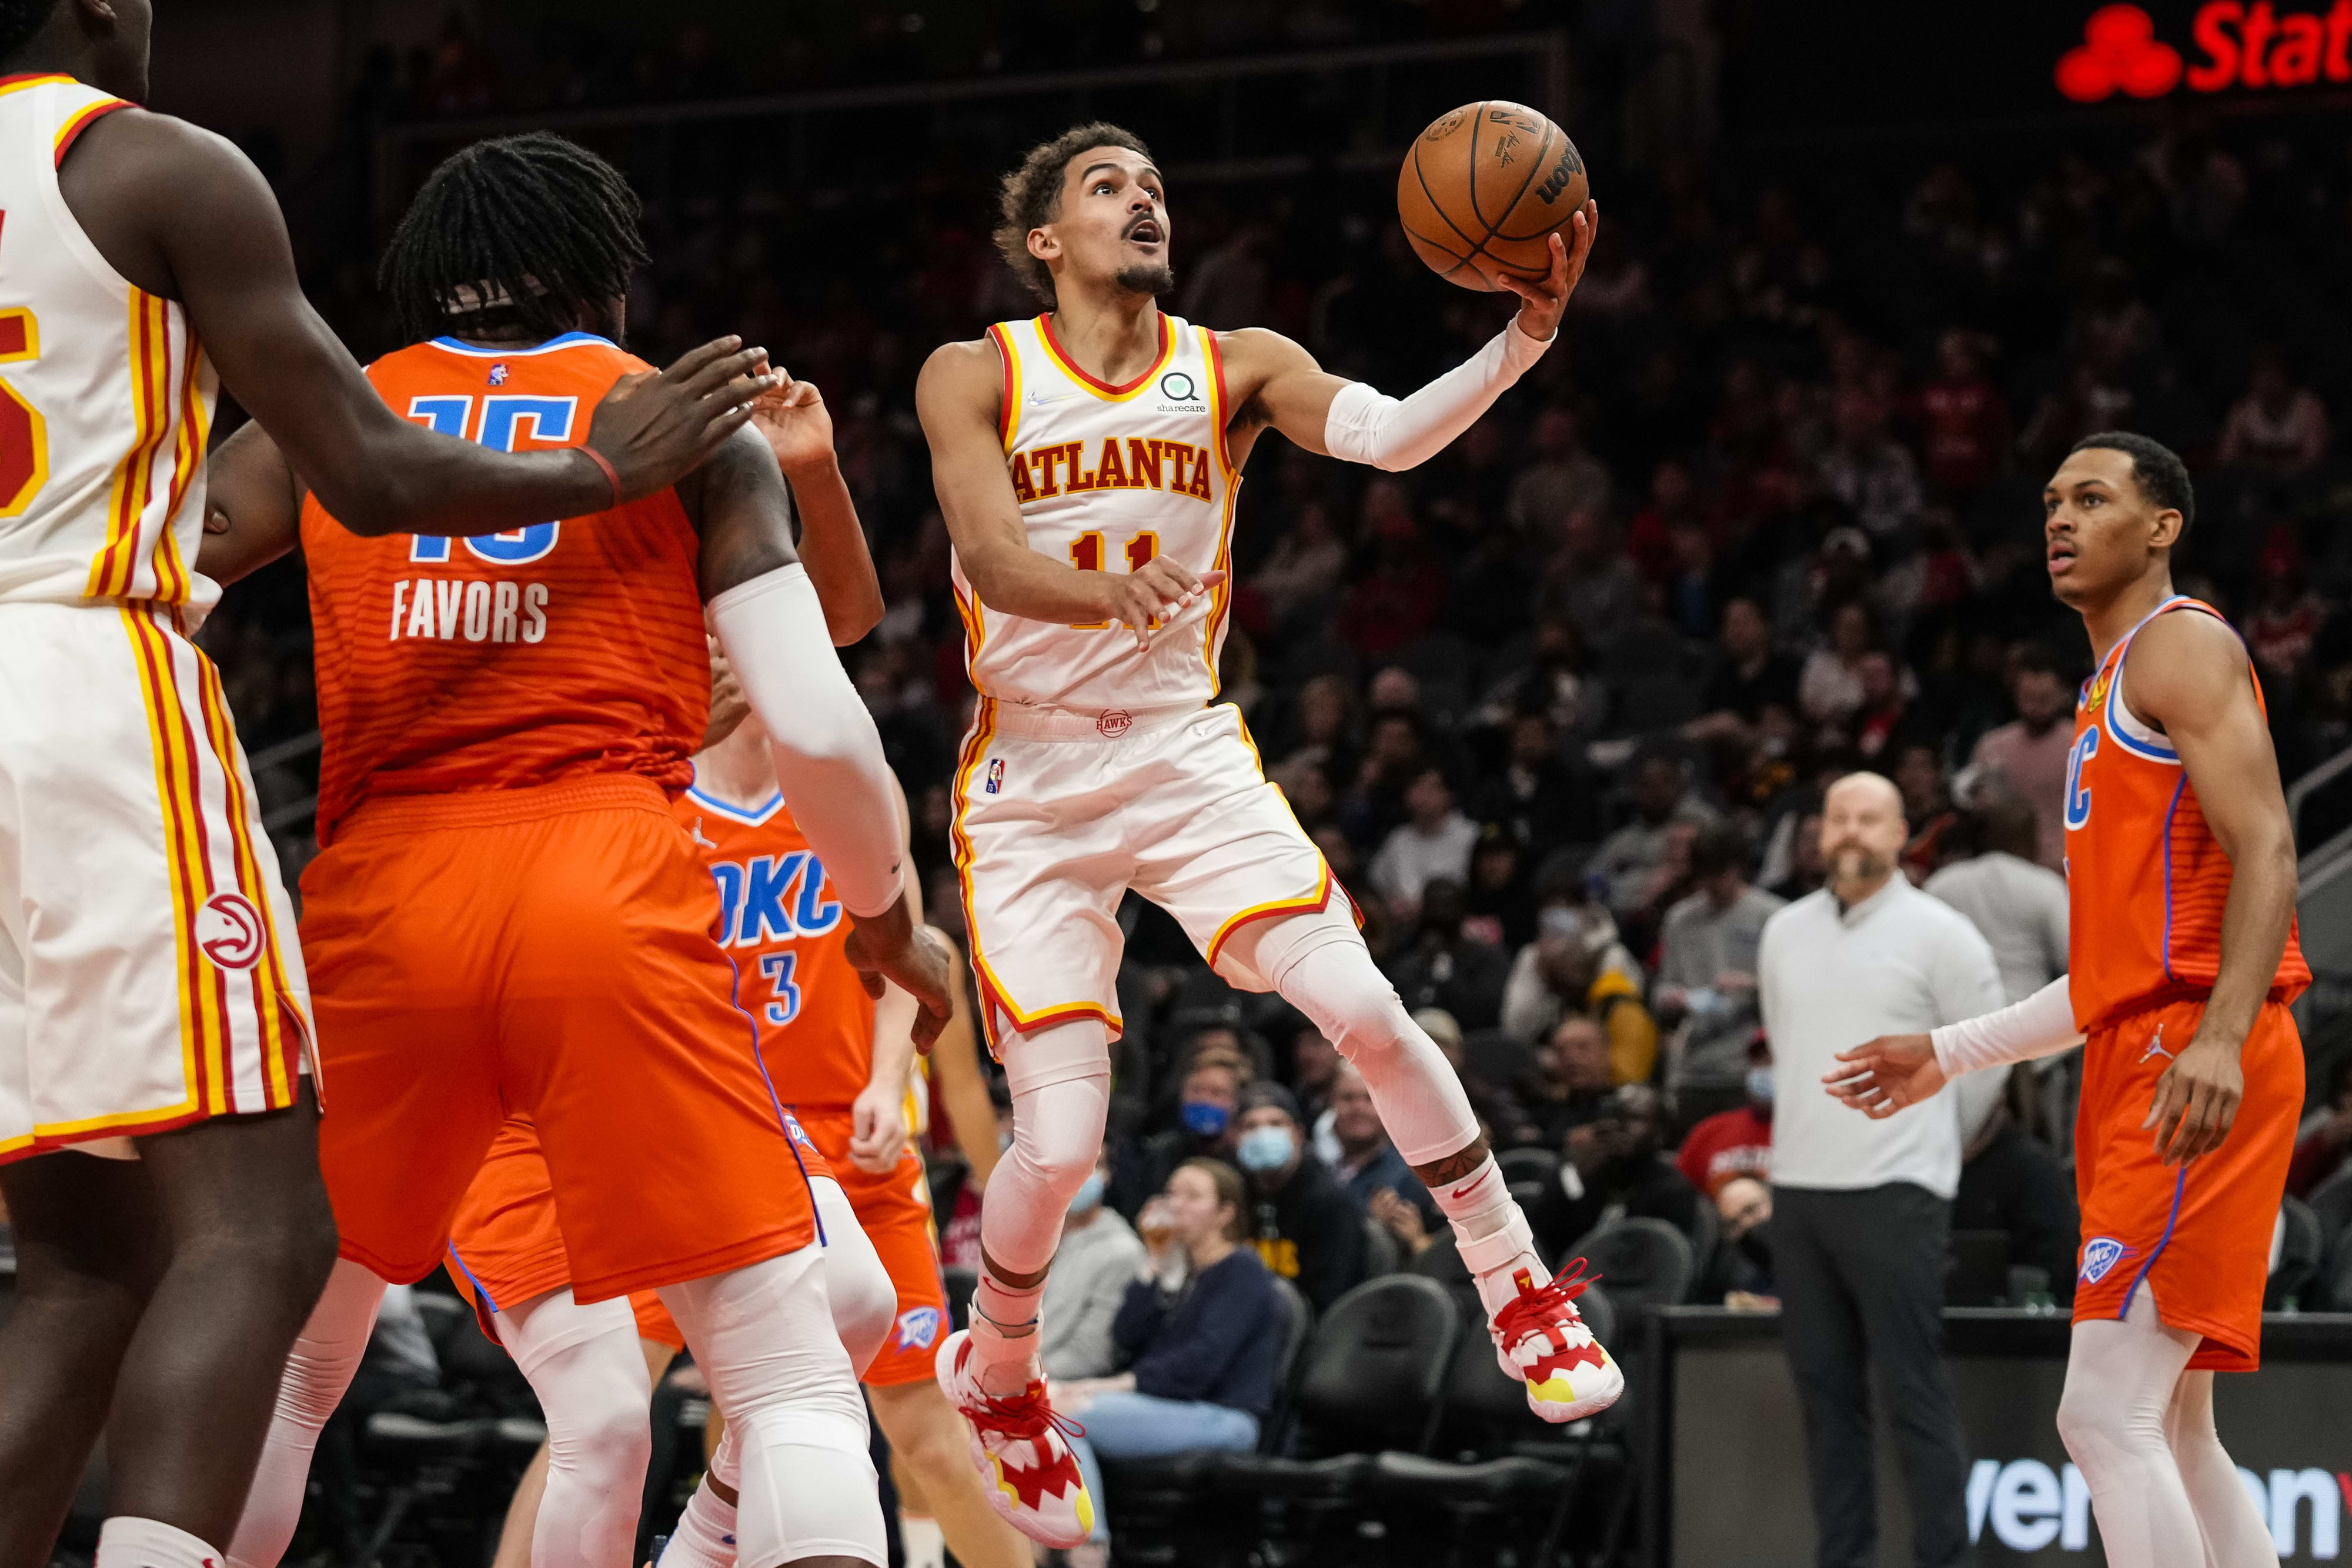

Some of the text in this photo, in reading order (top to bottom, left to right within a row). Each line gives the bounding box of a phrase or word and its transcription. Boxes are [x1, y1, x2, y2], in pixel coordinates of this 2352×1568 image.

[1157, 404, 1205, 412] sharecare
[1011, 437, 1212, 504] ATLANTA
[390, 579, 549, 644] FAVORS
[1096, 716, 1132, 730] HAWKS
[759, 950, 801, 1027] 3
